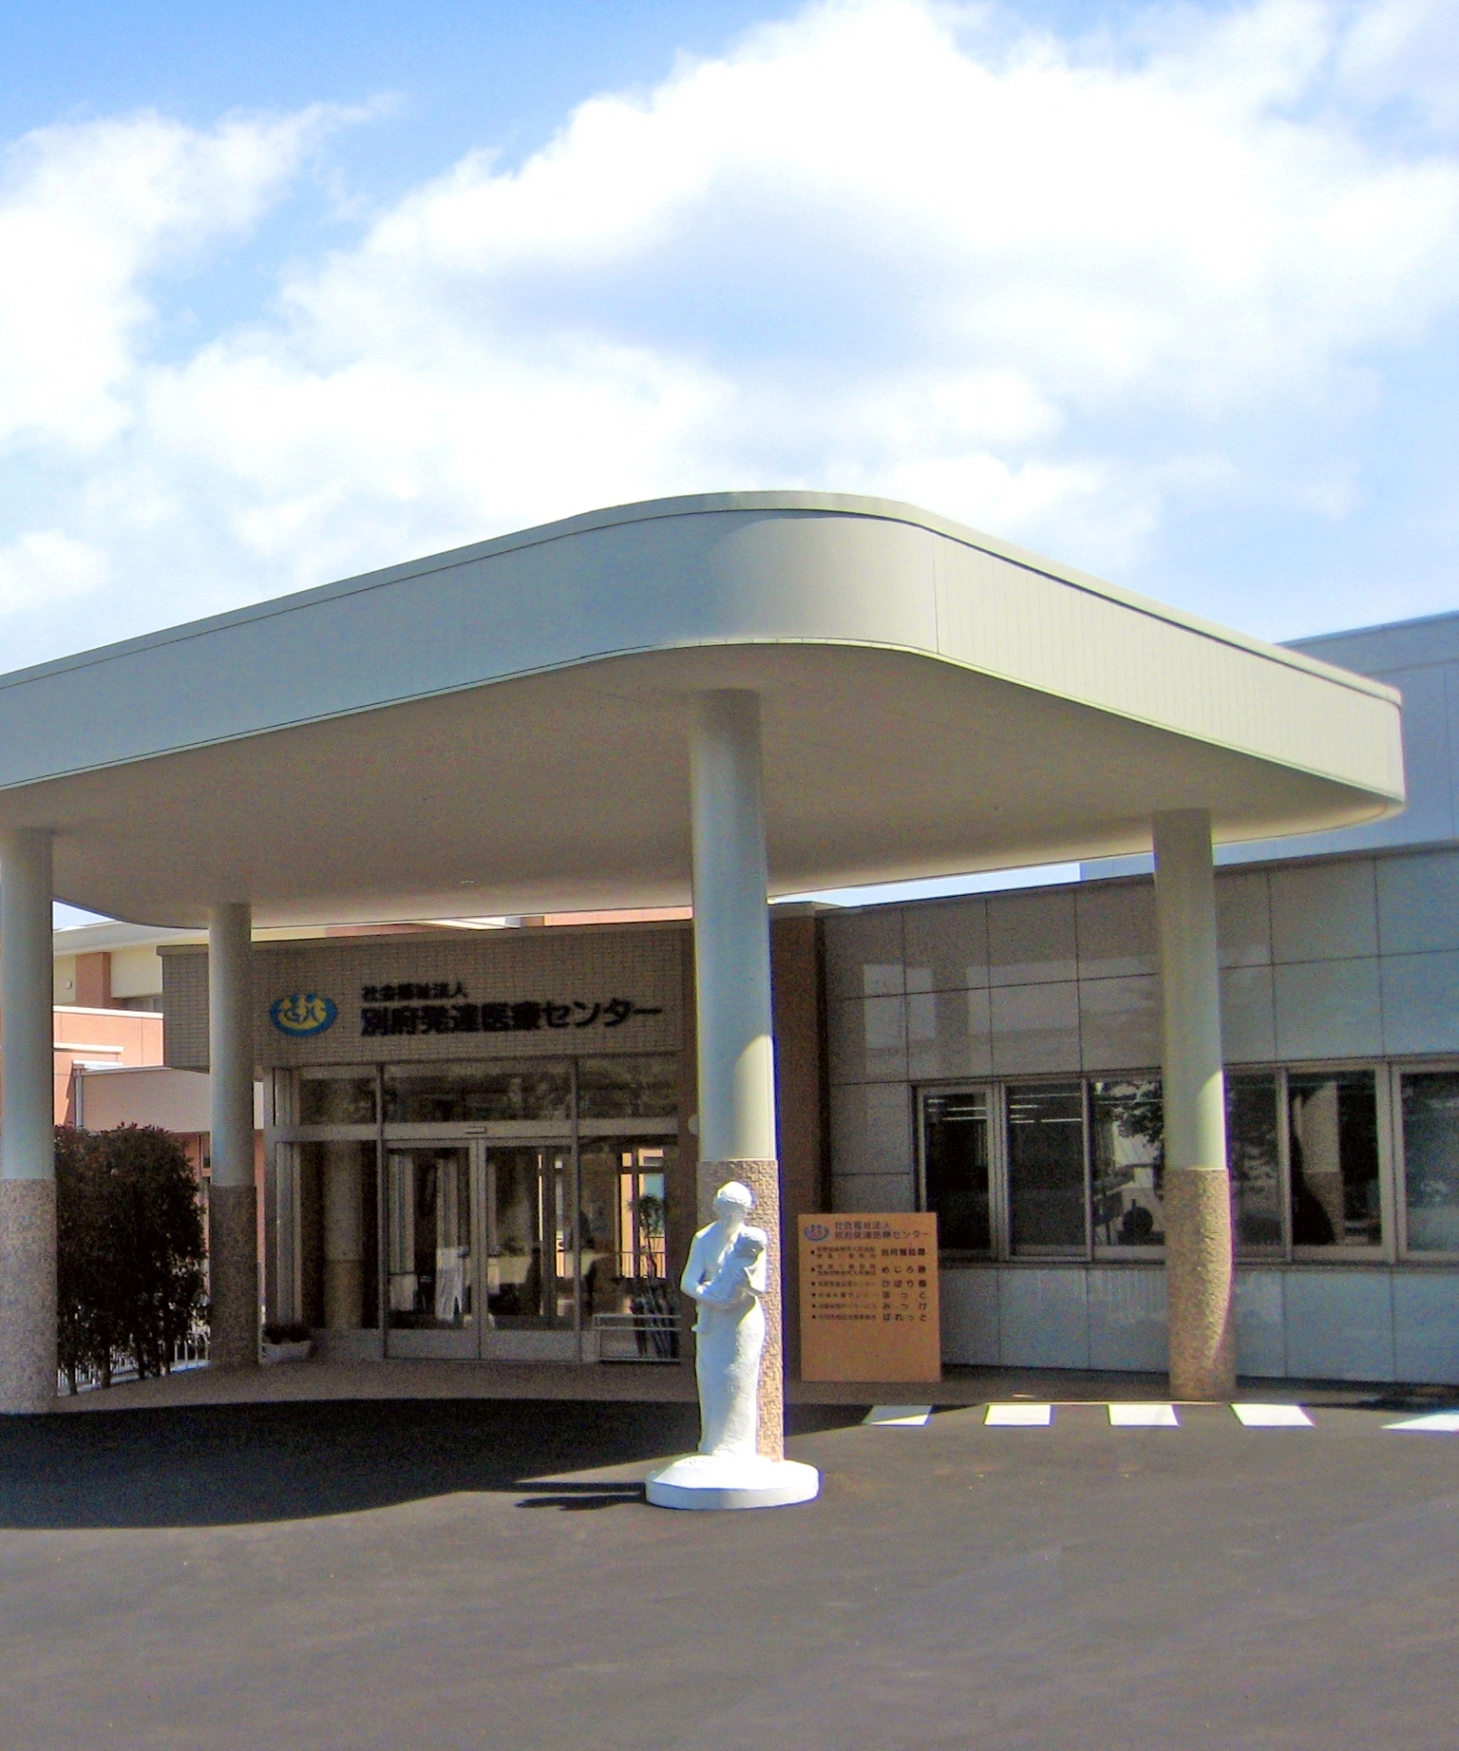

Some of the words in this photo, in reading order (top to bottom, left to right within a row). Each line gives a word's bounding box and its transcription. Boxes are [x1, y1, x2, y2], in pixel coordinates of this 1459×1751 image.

[361, 997, 663, 1037] 別府発達医療センター
